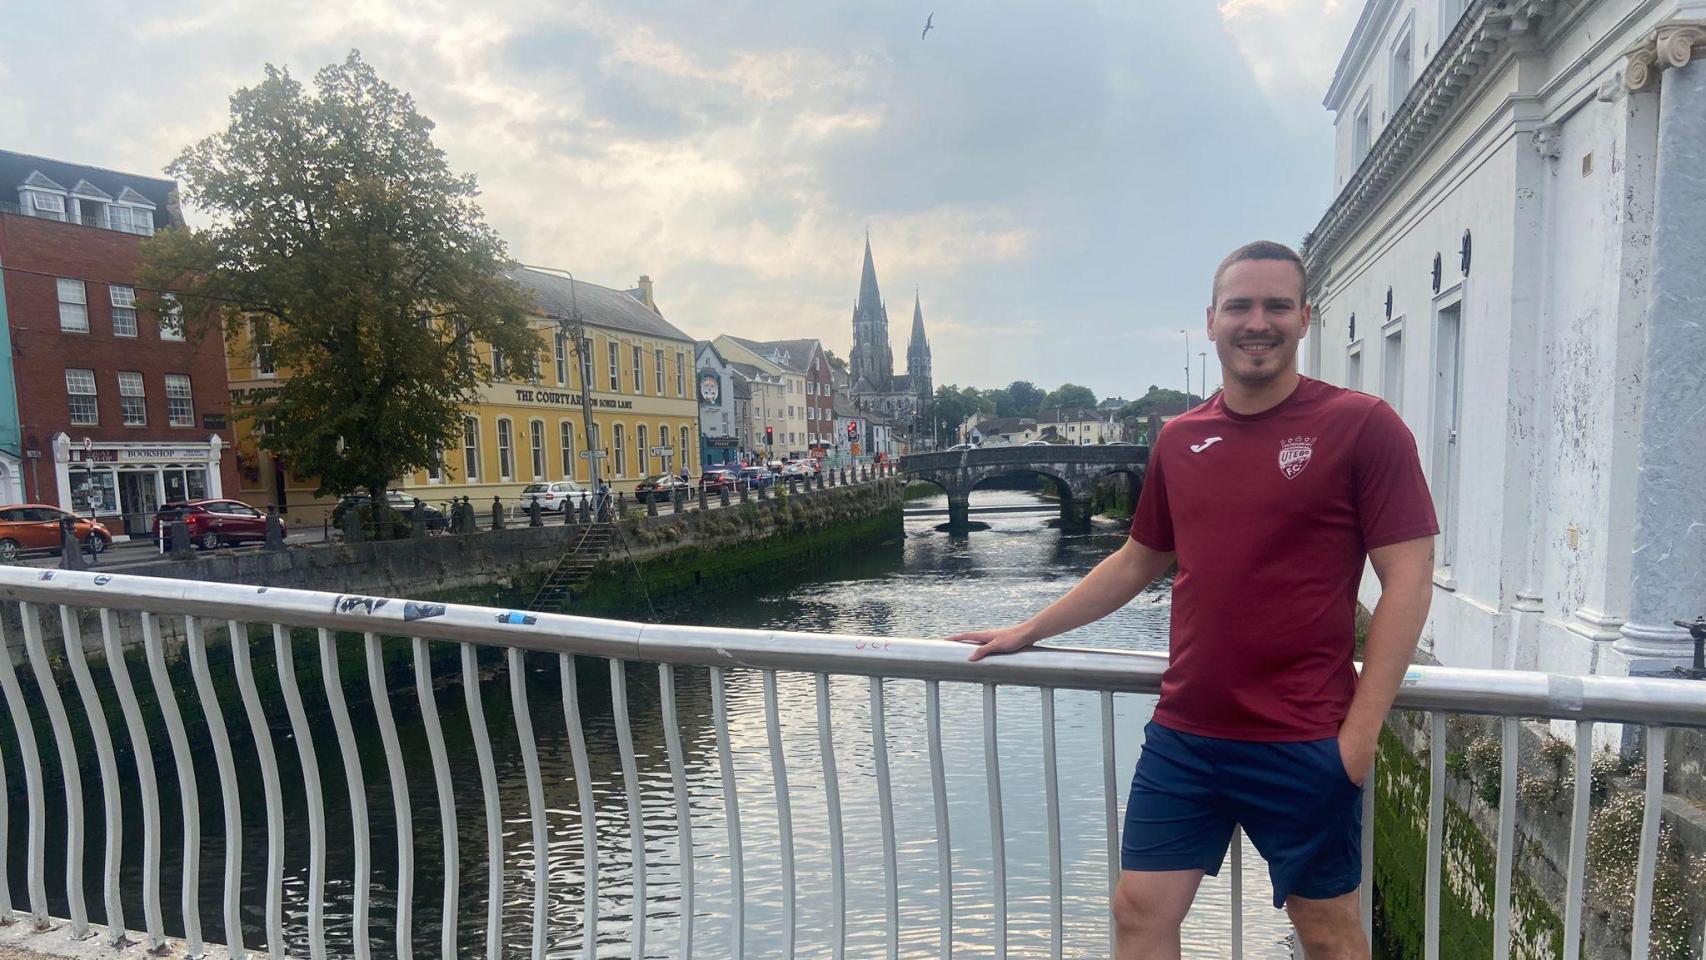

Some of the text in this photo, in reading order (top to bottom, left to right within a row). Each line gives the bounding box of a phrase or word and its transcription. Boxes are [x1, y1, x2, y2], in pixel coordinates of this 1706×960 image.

[516, 390, 533, 402] THE
[536, 391, 584, 406] COURTYAR
[128, 450, 175, 458] BOOKSHOP
